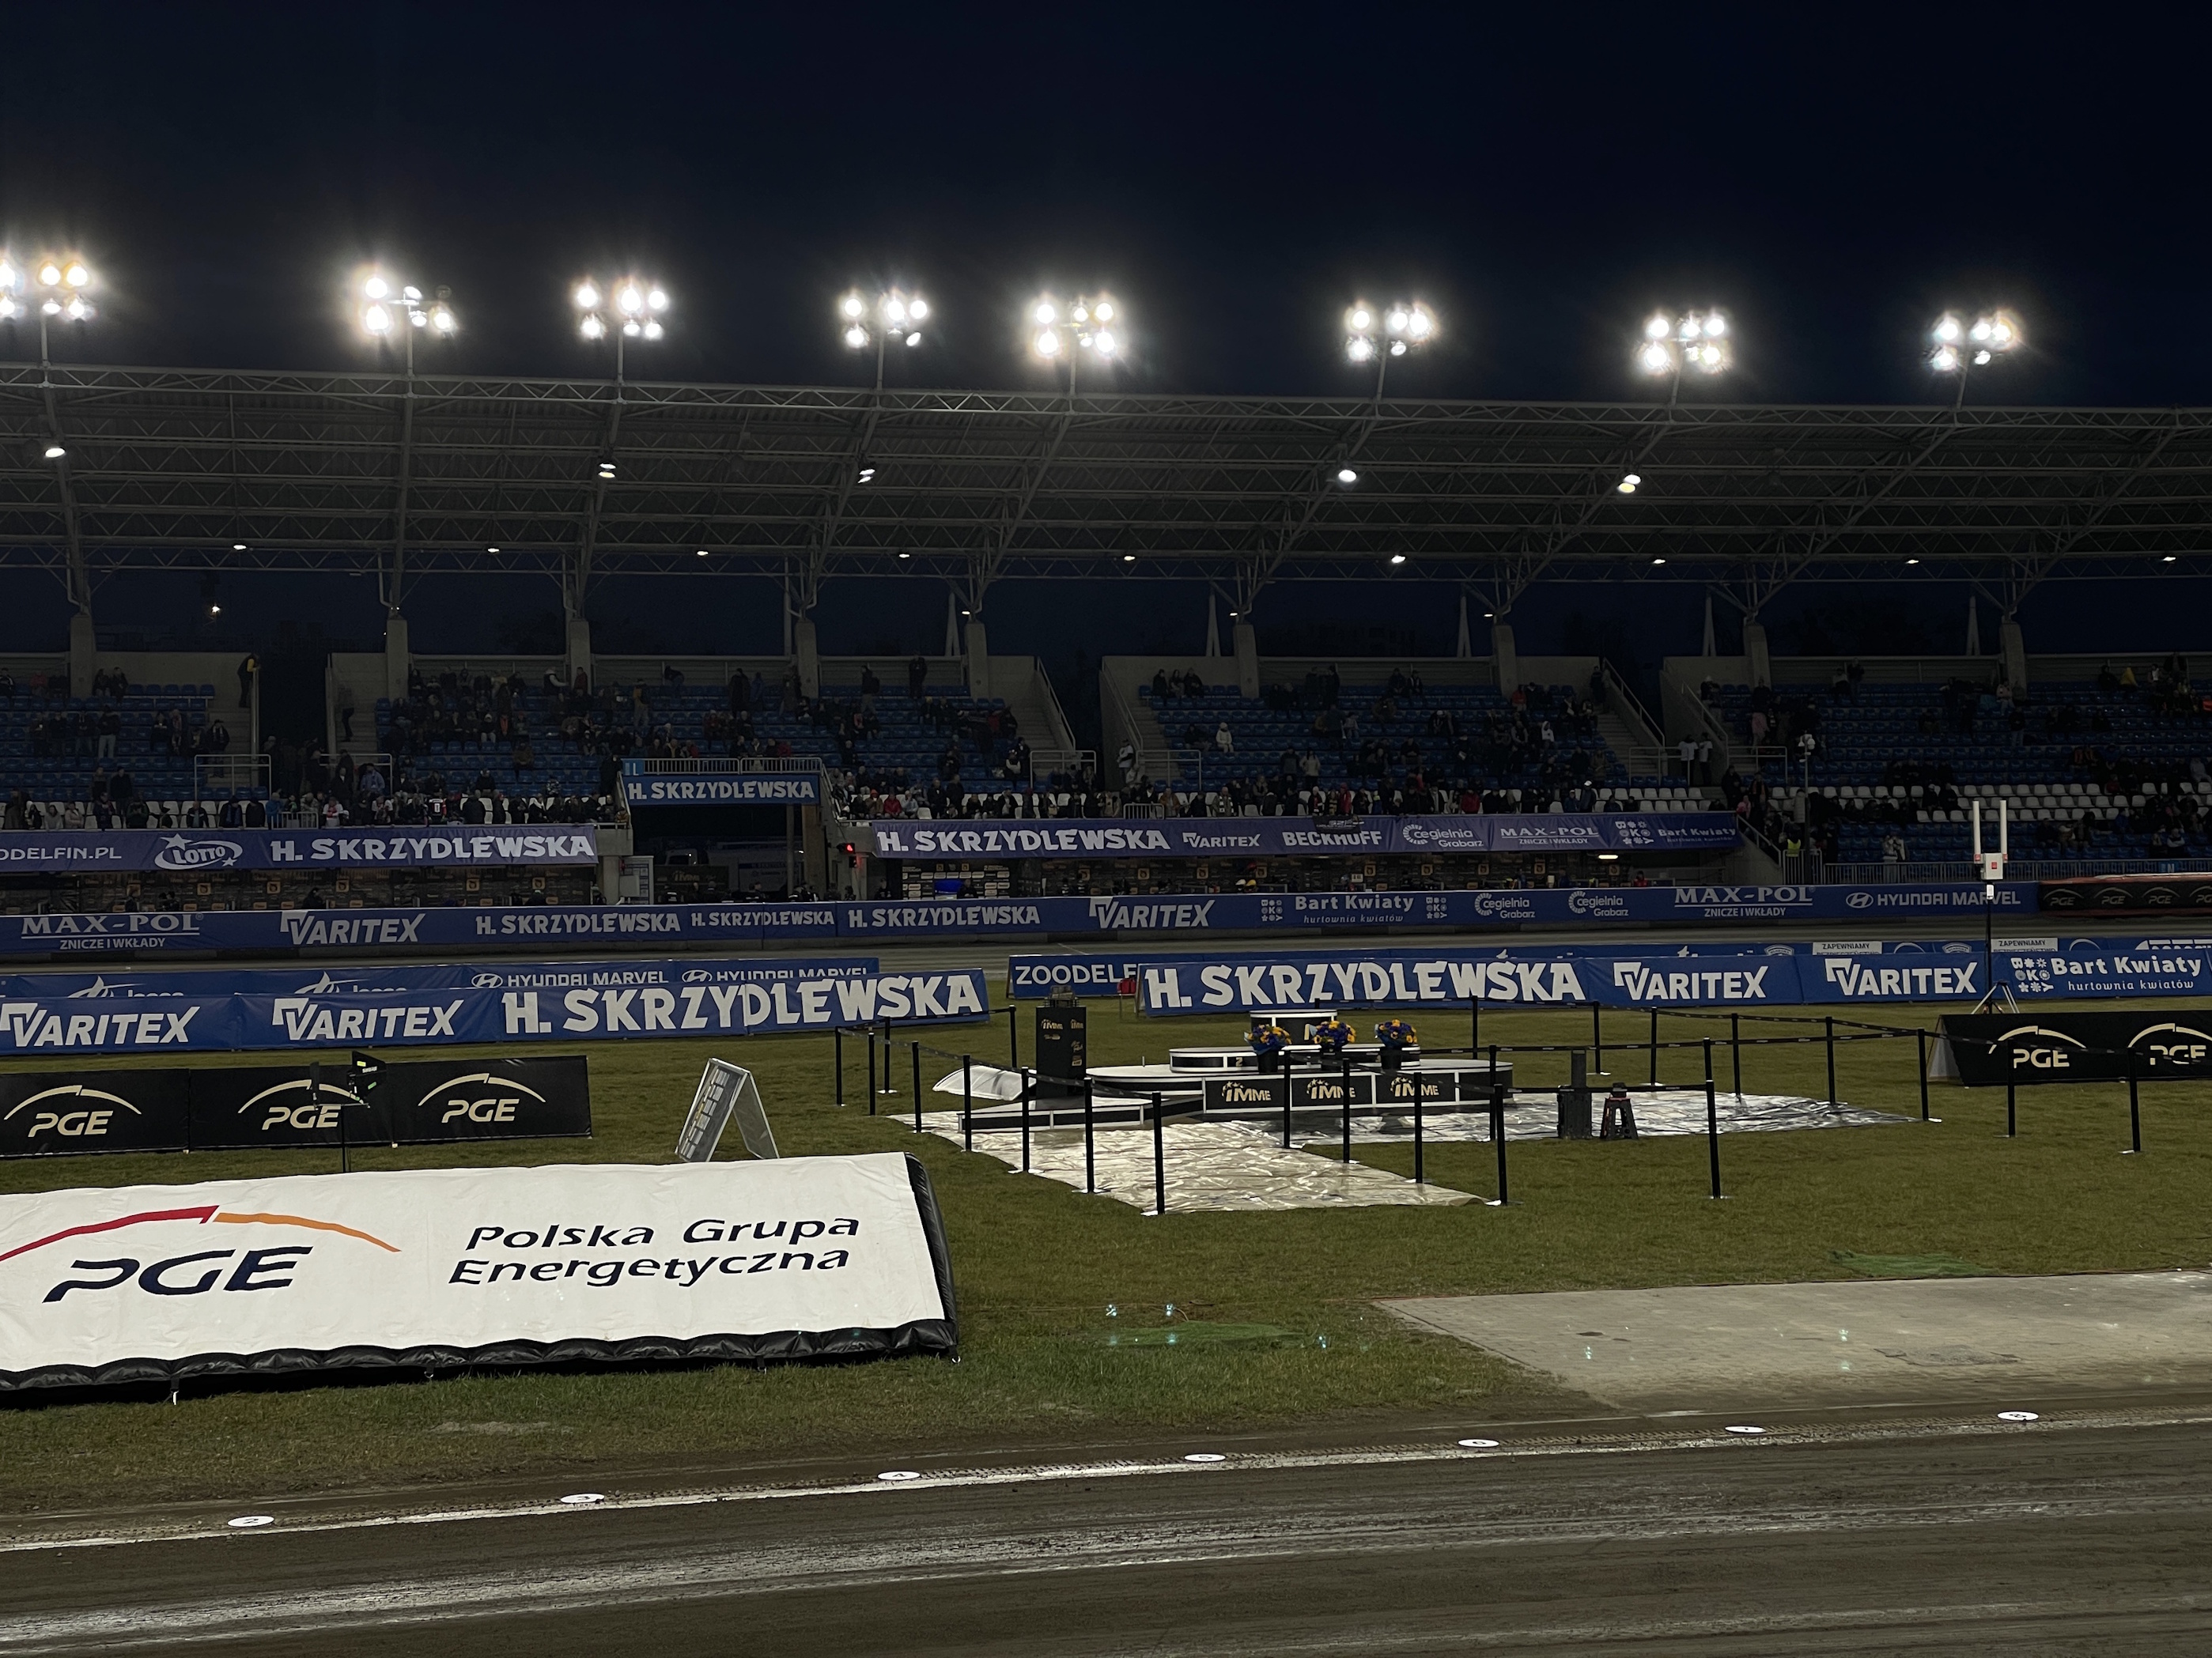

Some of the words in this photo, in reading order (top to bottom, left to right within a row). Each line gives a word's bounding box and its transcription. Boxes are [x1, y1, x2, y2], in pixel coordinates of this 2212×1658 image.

[628, 783, 647, 799] H.
[651, 781, 815, 799] SKRZYDLEWSKA
[876, 831, 909, 852] H.
[915, 829, 1170, 852] SKRZYDLEWSKA
[1182, 832, 1261, 848] VARITEX
[1500, 827, 1599, 837] MAX-POL
[1658, 828, 1688, 837] Bart
[1689, 827, 1737, 837] Kwiaty
[172, 846, 225, 863] LOTTO
[270, 840, 303, 862] H.
[311, 836, 595, 861] SKRZYDLEWSKA
[1295, 895, 1338, 910] Bart
[1345, 894, 1414, 912] Kwiaty
[1674, 887, 1813, 903] MAX-POL
[1877, 893, 1948, 905] HYUNDAI
[1953, 891, 2021, 905] MARVEL
[2050, 897, 2076, 906] PGE
[2100, 895, 2126, 905] PGE
[2148, 894, 2173, 905] PGE
[690, 912, 705, 927] H.
[709, 911, 834, 926] SKRZYDLEWSKA
[849, 908, 868, 927] H.
[872, 906, 1040, 927] SKRZYDLEWSKA
[1089, 897, 1215, 928] VARITEX
[1303, 915, 1356, 923] hurtownia
[1360, 914, 1404, 923] kwiatów
[1499, 909, 1535, 918] Grabarz
[1594, 908, 1628, 916] Grabarz
[1704, 908, 1738, 917] ZNICZE
[1741, 908, 1743, 916] I
[1745, 907, 1786, 916] WKŁADY
[21, 914, 199, 934] MAX-POL
[280, 912, 425, 945] VARITEX
[476, 916, 495, 935] H.
[501, 913, 680, 934] SKRZYDLEWSKA
[59, 939, 104, 950] ZNICZE
[107, 938, 111, 949] I
[114, 936, 165, 949] WKŁADY
[2051, 957, 2108, 975] Bart
[2114, 955, 2201, 976] Kwiaty
[508, 973, 588, 986] HYUNDAI
[592, 971, 668, 985] MARVEL
[1144, 968, 1192, 1008] H.
[1201, 961, 1586, 1007] SKRZYDLEWSKA
[1613, 961, 1767, 999] VARITEX
[1824, 958, 1977, 996] VARITEX
[2067, 980, 2134, 991] hurtownia
[2140, 980, 2194, 990] kwiatów
[501, 991, 552, 1033] H.
[564, 973, 981, 1032] SKRZYDLEWSKA
[0, 1003, 200, 1047] VARITEX
[272, 999, 463, 1040] VARITEX
[2013, 1048, 2070, 1069] PGE
[262, 1105, 340, 1130] PGE
[441, 1099, 520, 1124] PGE
[28, 1111, 113, 1137] PGE
[466, 1224, 654, 1250] Polska
[683, 1218, 859, 1246] Grupa
[43, 1246, 313, 1303] PGE
[448, 1249, 848, 1287] Energetyczna
